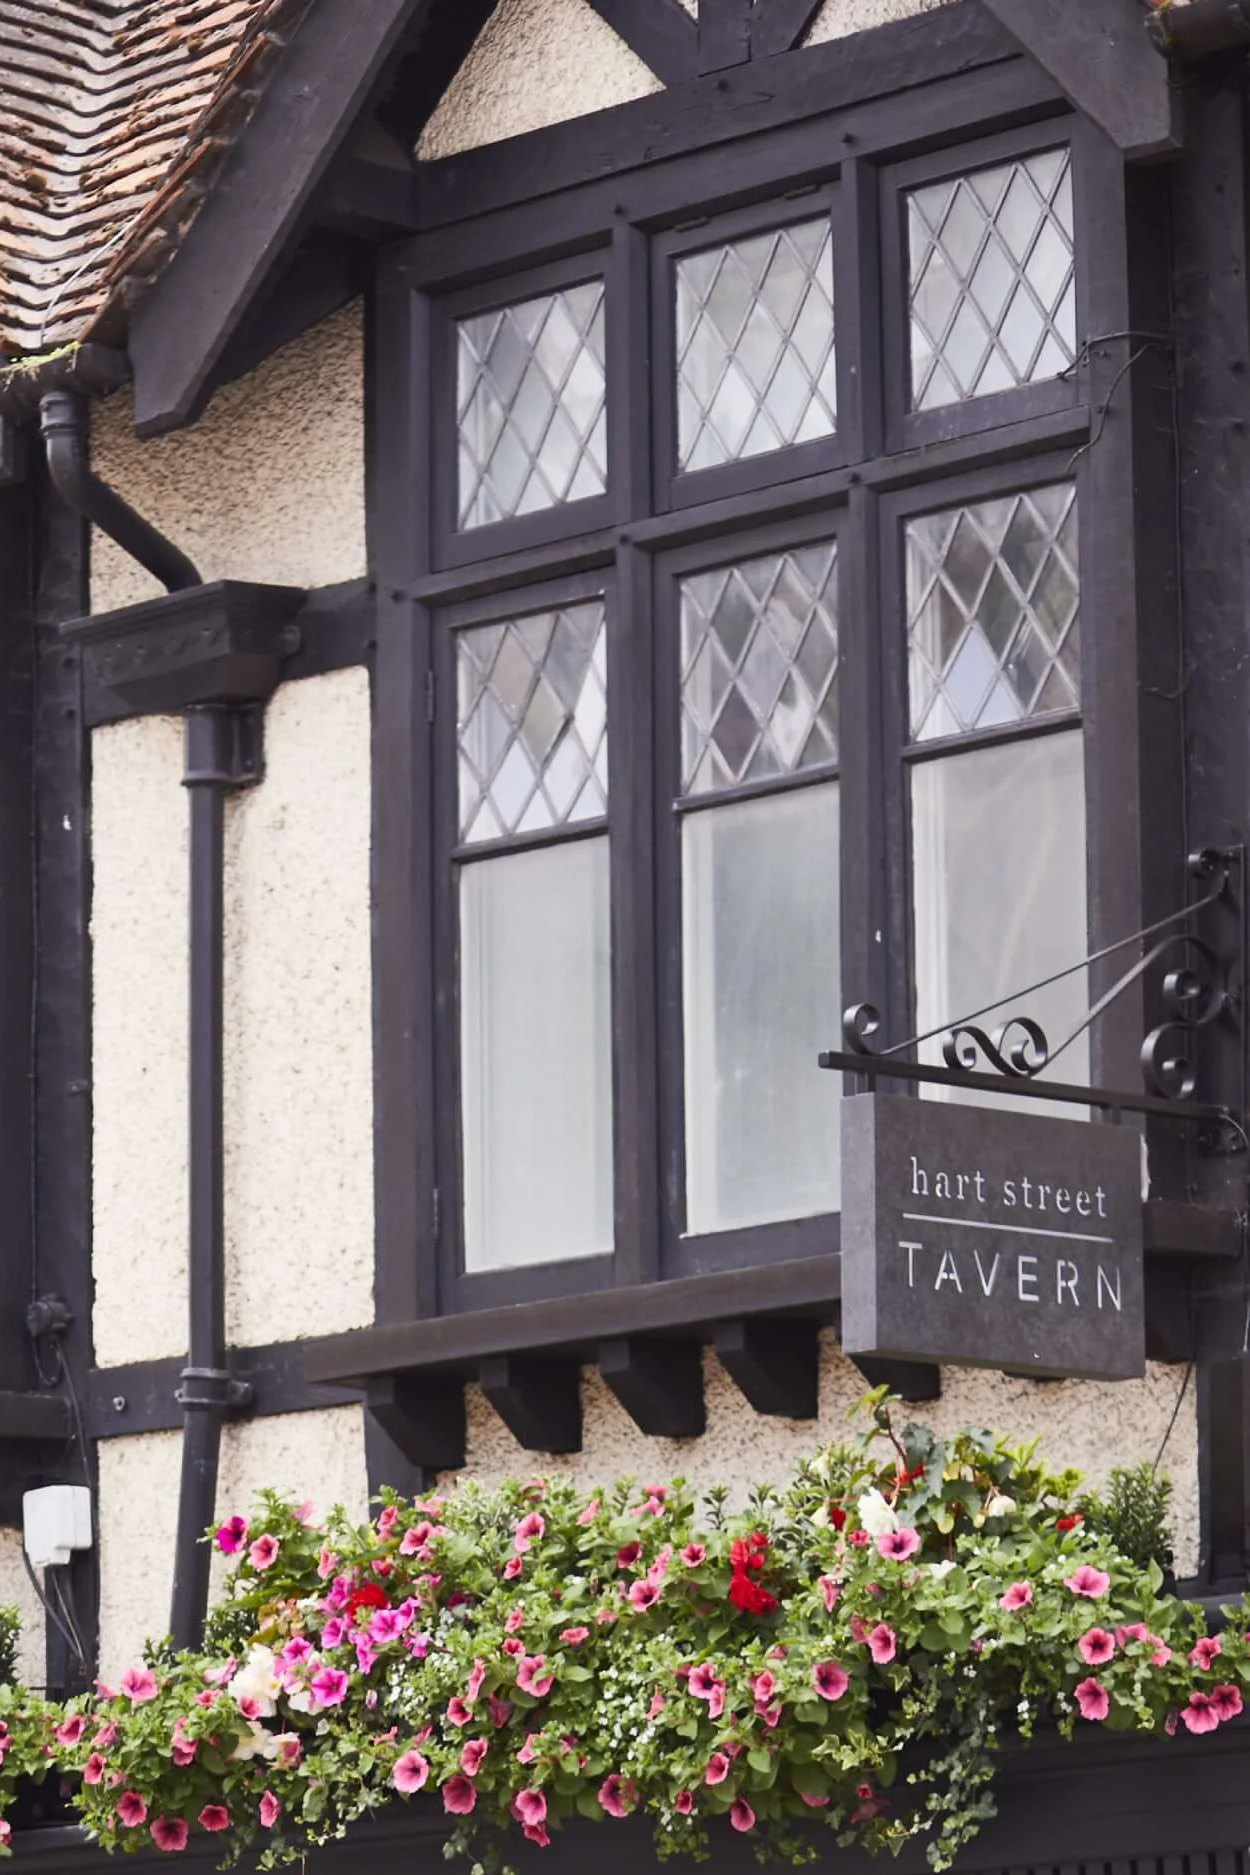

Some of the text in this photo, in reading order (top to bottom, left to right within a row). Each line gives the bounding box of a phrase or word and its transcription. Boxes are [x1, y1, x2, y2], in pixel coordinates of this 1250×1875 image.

[909, 1155, 1107, 1218] hart street
[897, 1240, 1123, 1312] TAVERN
